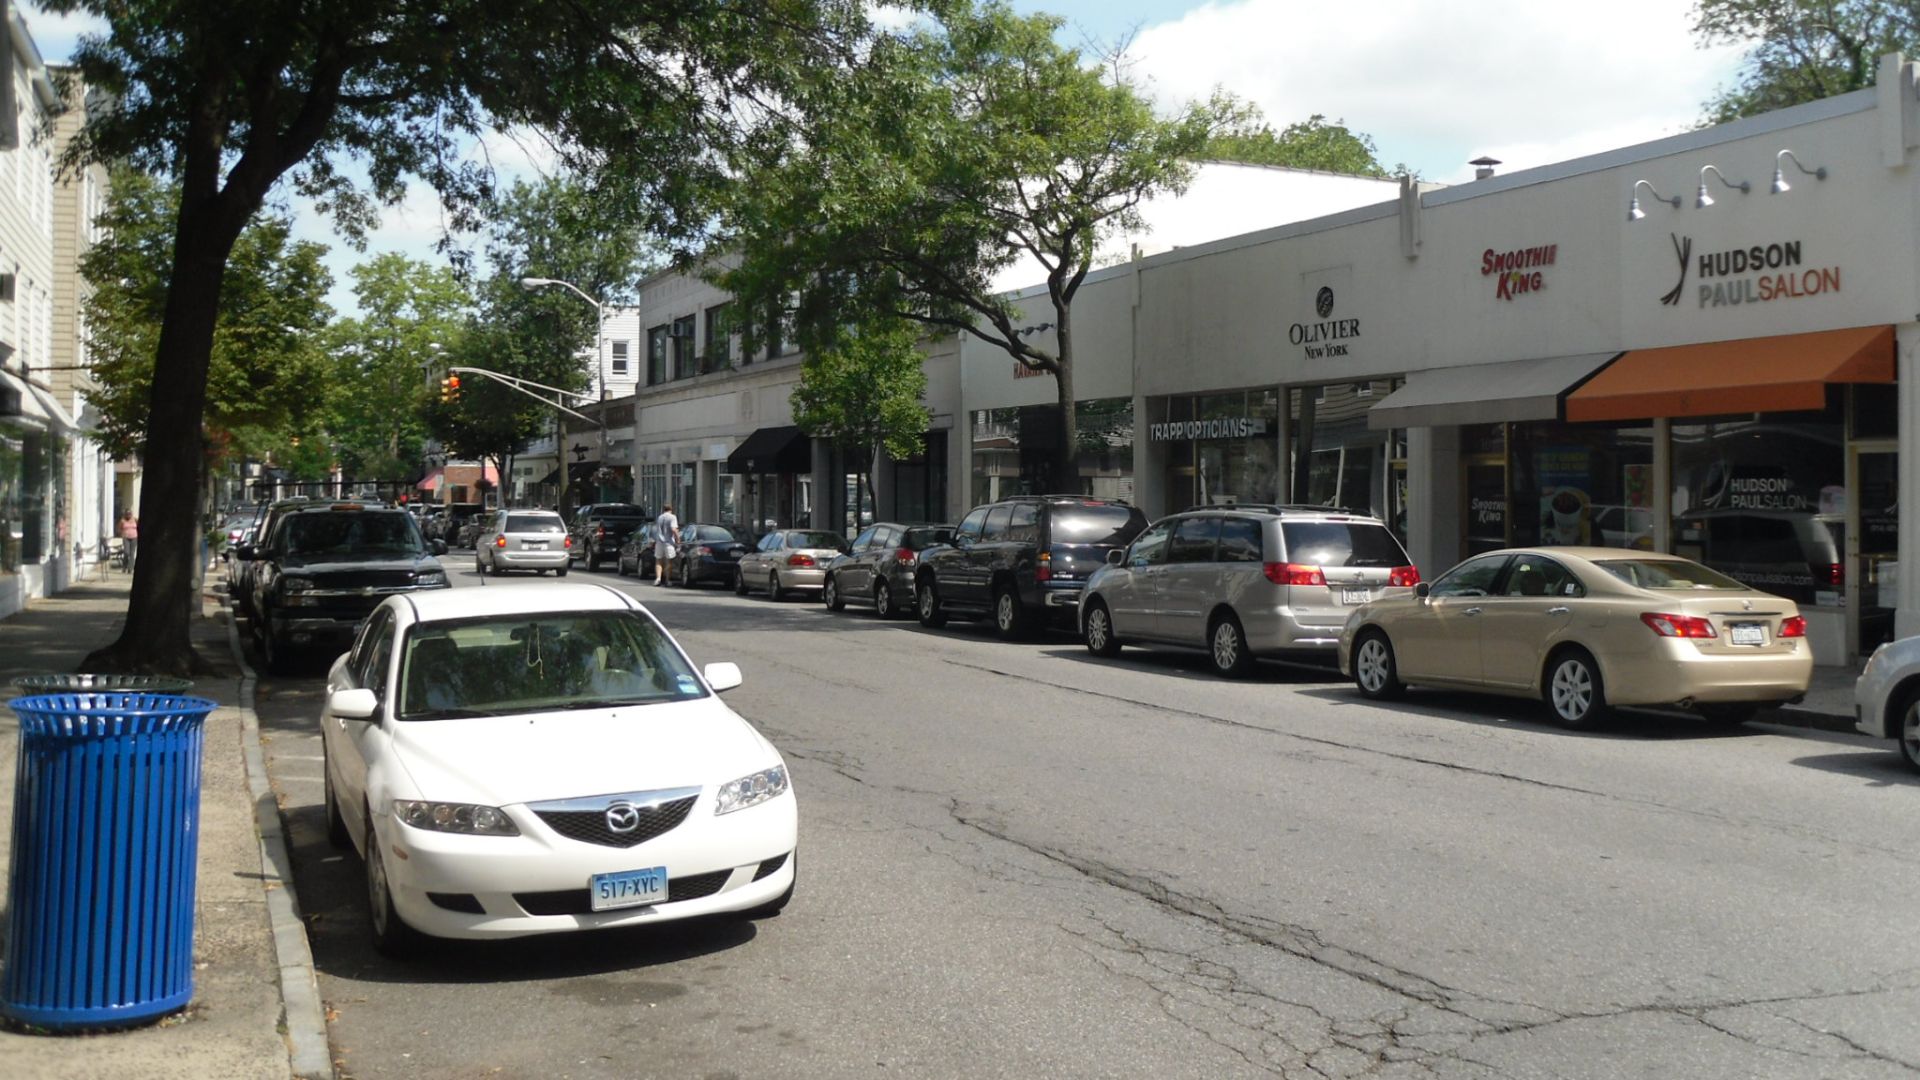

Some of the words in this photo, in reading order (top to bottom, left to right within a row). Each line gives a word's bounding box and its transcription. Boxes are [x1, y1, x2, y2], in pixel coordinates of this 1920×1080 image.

[1481, 244, 1557, 276] SMOOTHIE
[1699, 241, 1801, 278] HUDSON
[1496, 271, 1542, 301] KING
[1289, 319, 1361, 345] OLIVIER
[1150, 421, 1183, 440] TRAPP
[1187, 418, 1247, 439] OPTICIANS
[1731, 478, 1787, 492] HUDSON
